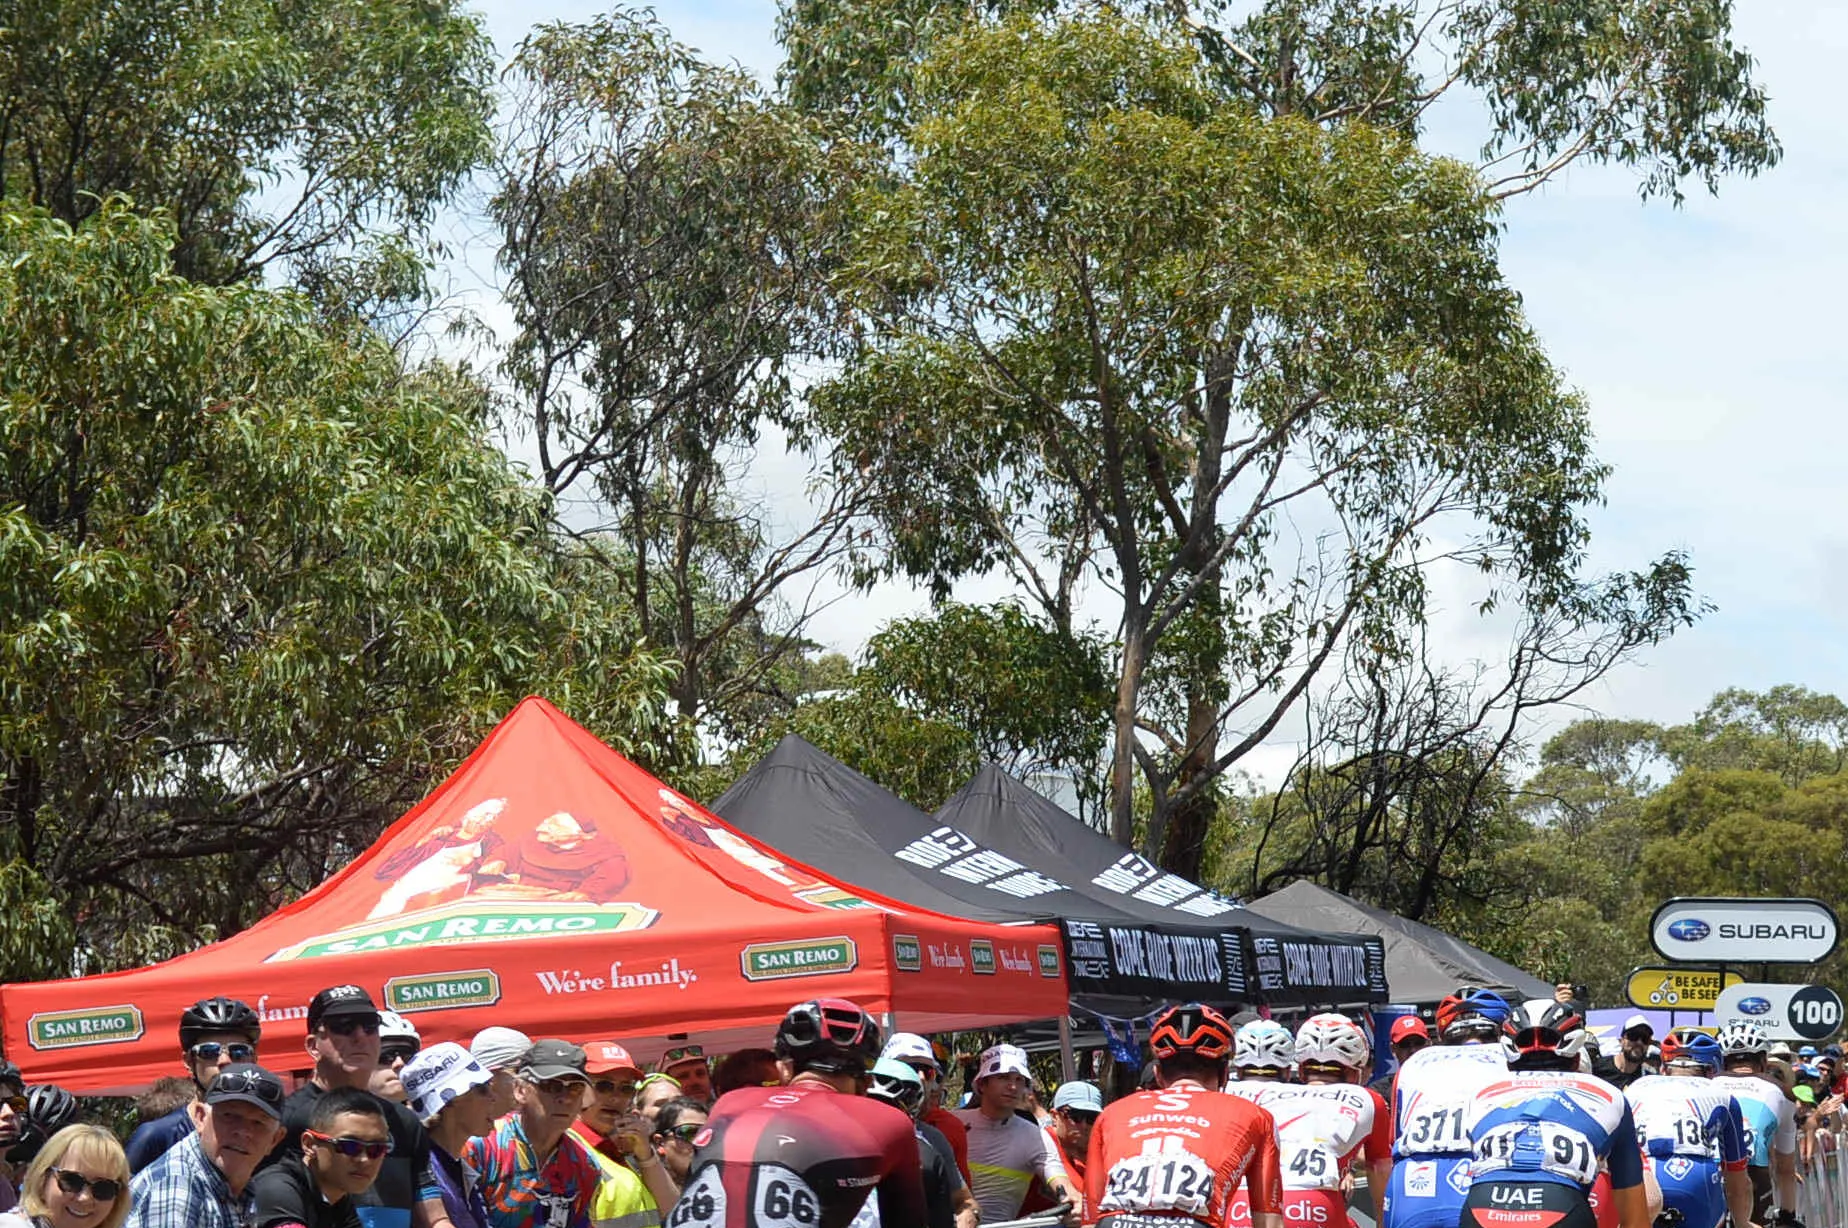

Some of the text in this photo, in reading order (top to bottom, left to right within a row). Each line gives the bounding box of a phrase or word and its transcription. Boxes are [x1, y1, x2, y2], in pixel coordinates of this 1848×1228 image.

[325, 916, 597, 956] SAN REMO
[1719, 924, 1825, 940] SUBARU
[757, 947, 839, 969] SAN REMO
[1109, 927, 1149, 976] COME
[1144, 931, 1176, 981] RIDE
[1170, 936, 1207, 982] WITH
[1203, 938, 1222, 983] US
[536, 958, 698, 996] We're family.
[1675, 975, 1720, 988] BE SAFE
[401, 981, 482, 1001] SAN REMO
[1681, 989, 1696, 999] BE
[1792, 1000, 1837, 1025] 100
[44, 1016, 126, 1038] SAN REMO
[405, 1052, 461, 1090] SUBARU
[1128, 1113, 1211, 1128] sunweb
[1290, 1148, 1327, 1177] 45
[1552, 1134, 1591, 1172] 91
[1162, 1160, 1213, 1199] 124
[764, 1180, 816, 1224] 66
[1490, 1186, 1544, 1205] UAE
[1487, 1210, 1542, 1223] Emirates
